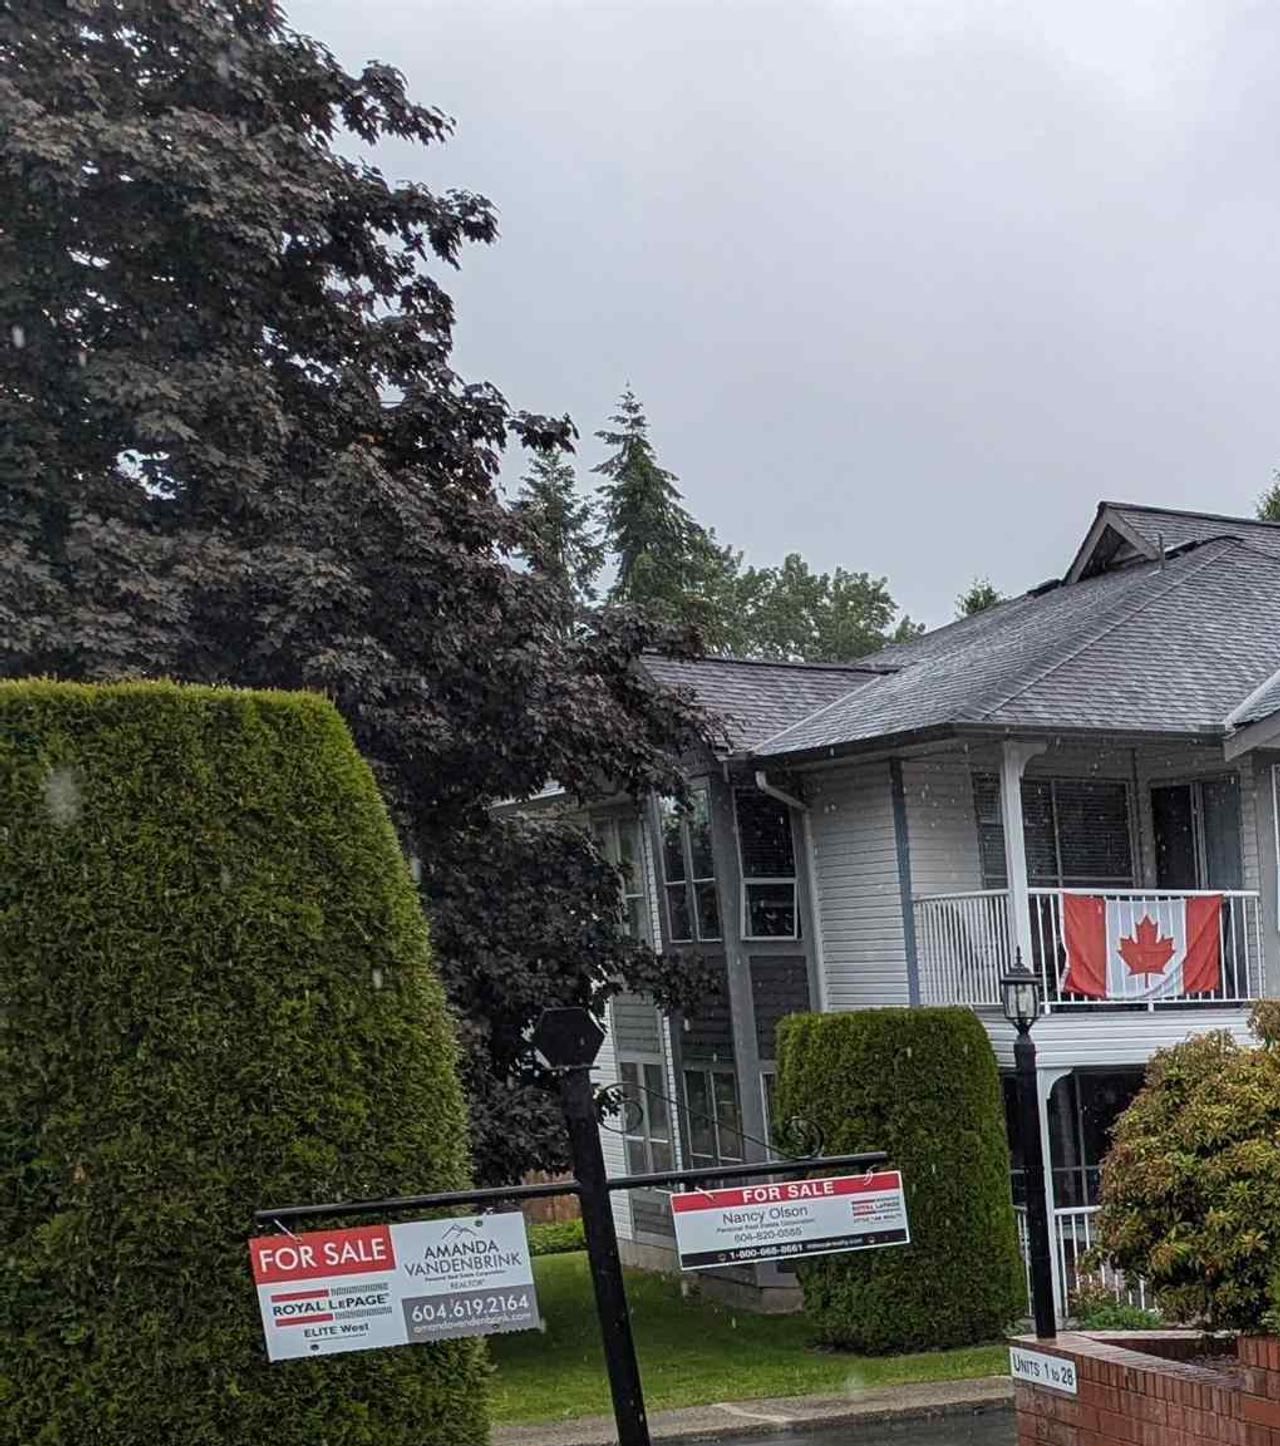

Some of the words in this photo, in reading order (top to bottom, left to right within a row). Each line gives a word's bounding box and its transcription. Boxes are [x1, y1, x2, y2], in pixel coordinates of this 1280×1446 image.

[742, 1187, 781, 1203] FOR
[787, 1181, 834, 1198] SALE
[722, 1211, 766, 1225] Nancy
[769, 1206, 809, 1220] Olson
[259, 1245, 318, 1273] FOR
[323, 1238, 387, 1266] SALE
[424, 1240, 500, 1259] AMANDA
[404, 1252, 522, 1276] VANDENBRINK
[272, 1301, 327, 1317] ROYAL
[412, 1294, 530, 1323] 604.619.2164
[304, 1326, 338, 1338] ELITE
[1044, 1362, 1049, 1379] 1
[1061, 1366, 1074, 1386] 28
